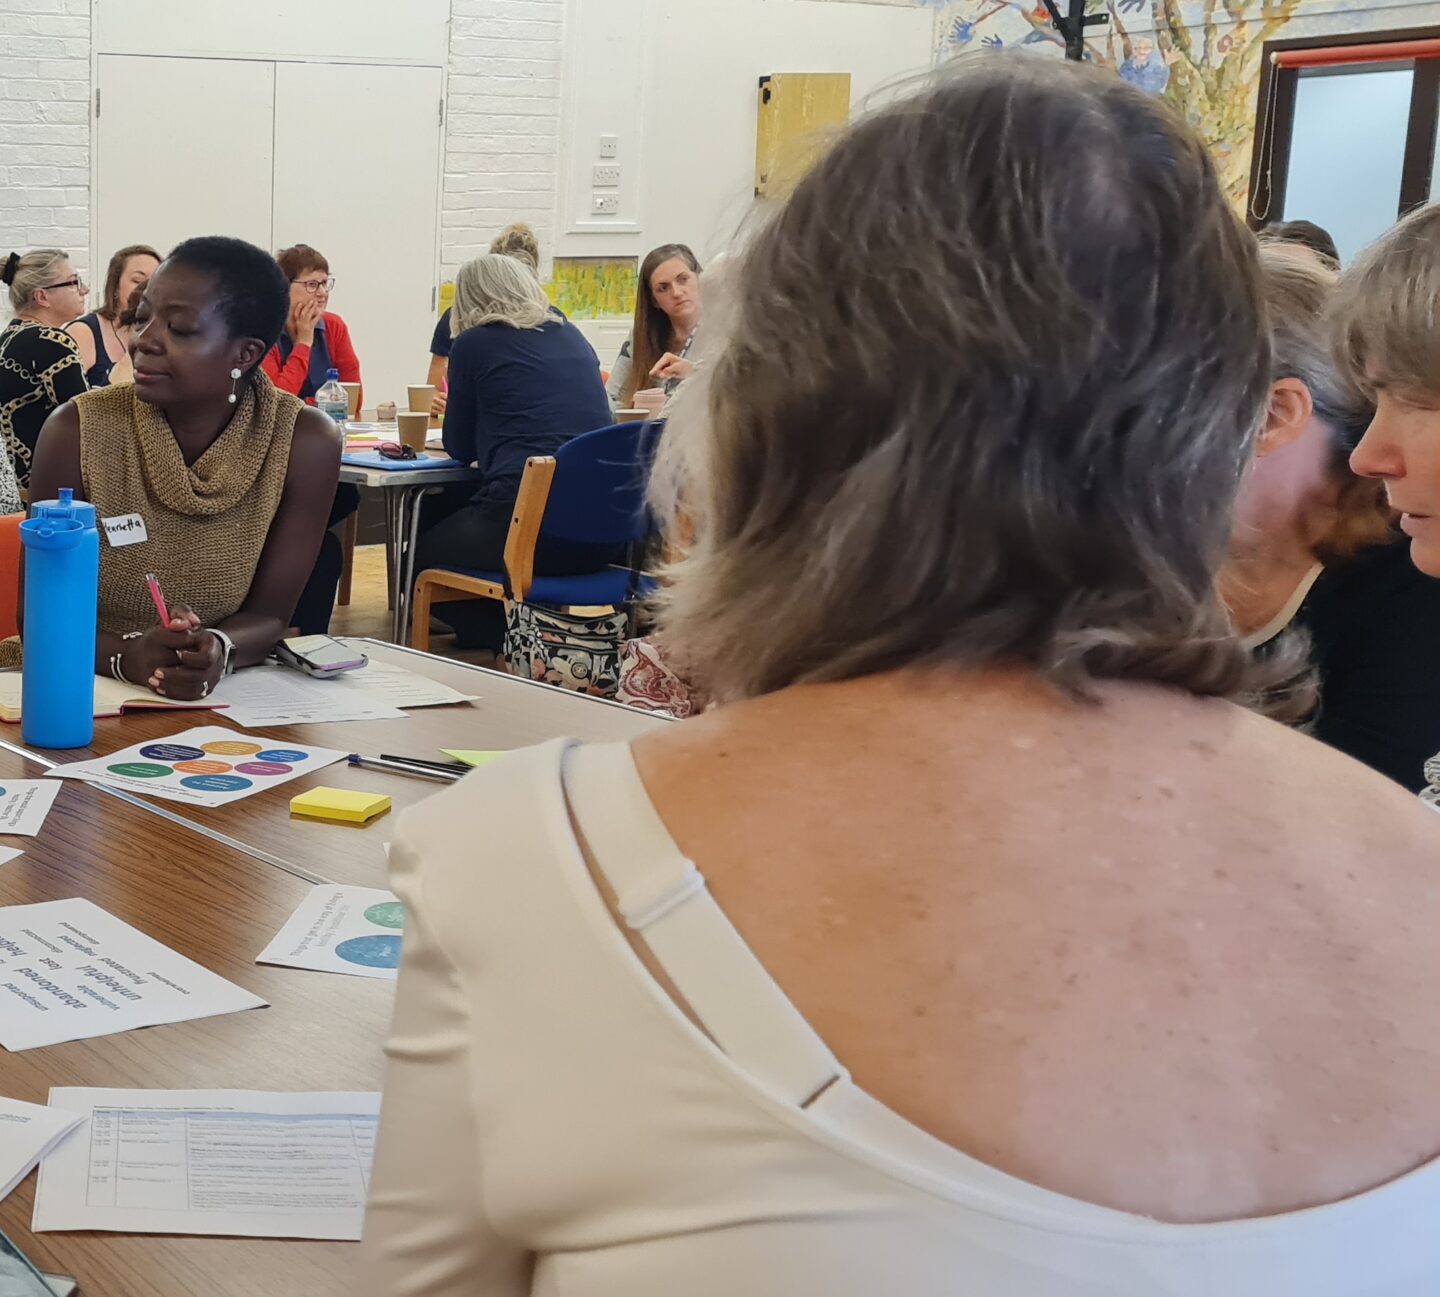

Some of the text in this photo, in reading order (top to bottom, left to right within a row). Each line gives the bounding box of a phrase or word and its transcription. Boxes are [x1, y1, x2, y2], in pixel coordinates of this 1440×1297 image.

[56, 934, 99, 957] neglected
[38, 957, 64, 971] lost
[97, 956, 149, 986] frustrated
[12, 966, 88, 1010] abandoned
[74, 964, 143, 1001] unhelpful
[75, 983, 121, 1012] vulnerable
